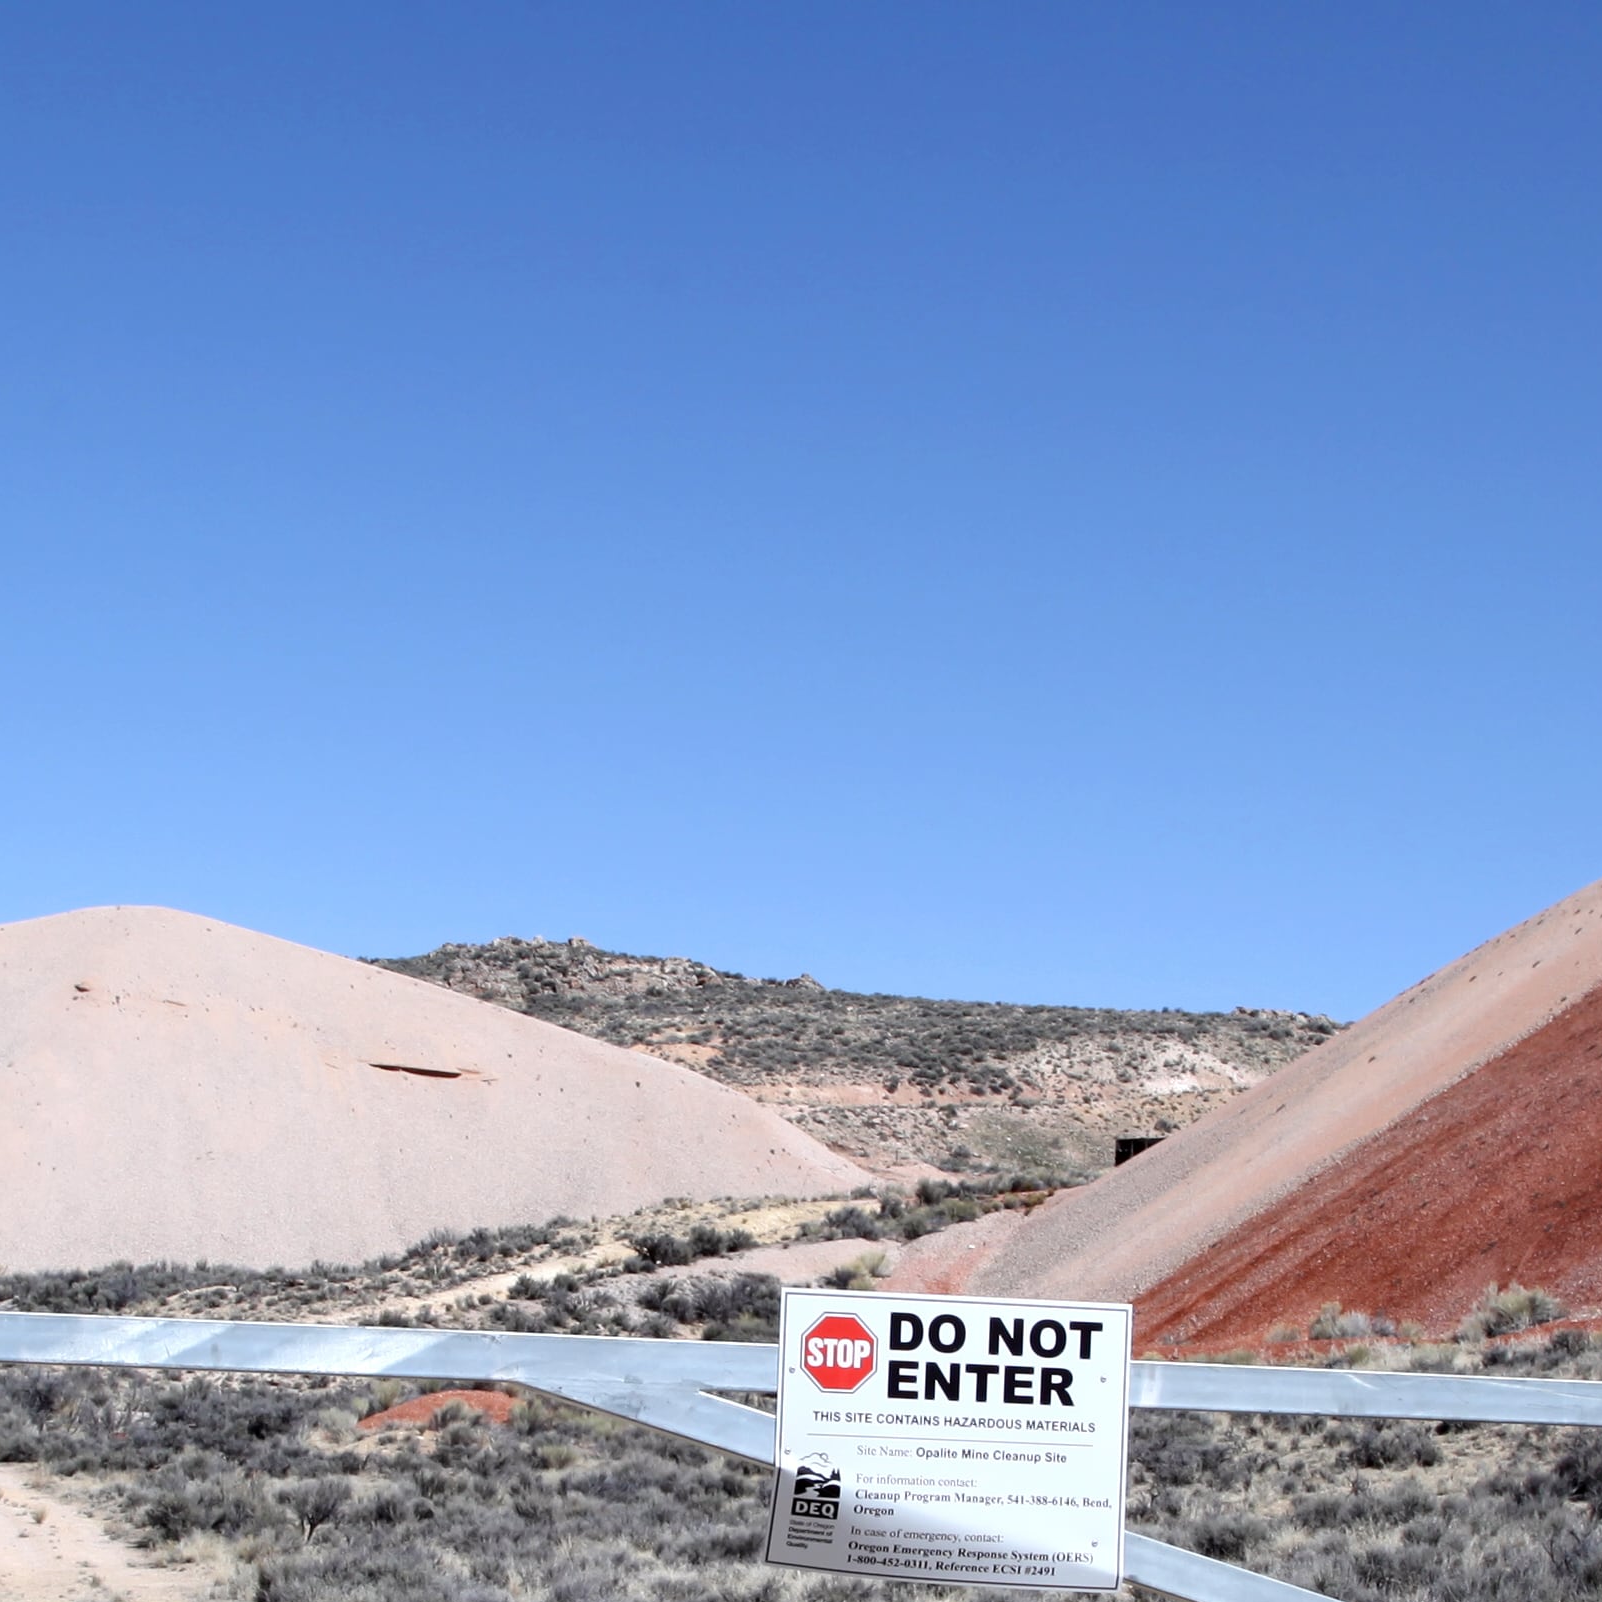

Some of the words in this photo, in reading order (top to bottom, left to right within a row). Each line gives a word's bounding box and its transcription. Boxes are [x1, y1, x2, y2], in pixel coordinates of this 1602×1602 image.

[890, 1312, 966, 1353] DO
[989, 1318, 1103, 1360] NOT
[807, 1338, 870, 1368] STOP
[887, 1361, 1074, 1406] ENTER
[813, 1411, 840, 1423] THIS
[845, 1412, 872, 1424] SITE
[876, 1413, 940, 1427] CONTAINS
[943, 1417, 1021, 1430] HAZARDOUS
[1026, 1420, 1096, 1433] MATERIALS
[857, 1445, 877, 1456] Site
[879, 1447, 912, 1457] Name:
[916, 1447, 957, 1460] Opalite
[962, 1450, 989, 1460] Mine
[993, 1450, 1041, 1464] Cleanup
[1045, 1453, 1067, 1463] Site
[856, 1474, 873, 1483] For
[877, 1474, 935, 1486] information
[938, 1476, 977, 1488] contact:
[855, 1489, 900, 1502] Cleanup
[905, 1493, 951, 1505] Program
[955, 1493, 1004, 1505] Manager,
[1007, 1495, 1079, 1507] 541-388-6146,
[1083, 1498, 1112, 1508] Bend,
[795, 1501, 835, 1518] DEQ
[854, 1504, 894, 1517] Oregon
[851, 1526, 861, 1535] In
[865, 1529, 886, 1538] case
[890, 1529, 902, 1538] of
[904, 1531, 961, 1542] emergency,
[965, 1534, 1003, 1543] contact:
[848, 1541, 889, 1553] Oregon
[893, 1543, 954, 1557] Emergency
[958, 1549, 1008, 1560] Response
[1010, 1550, 1049, 1562] System
[1052, 1552, 1093, 1564] (OERS)
[847, 1555, 932, 1570] 1-800-452-0311,
[935, 1562, 989, 1574] Reference
[993, 1565, 1021, 1574] ECSI
[1024, 1566, 1056, 1576] #2491
